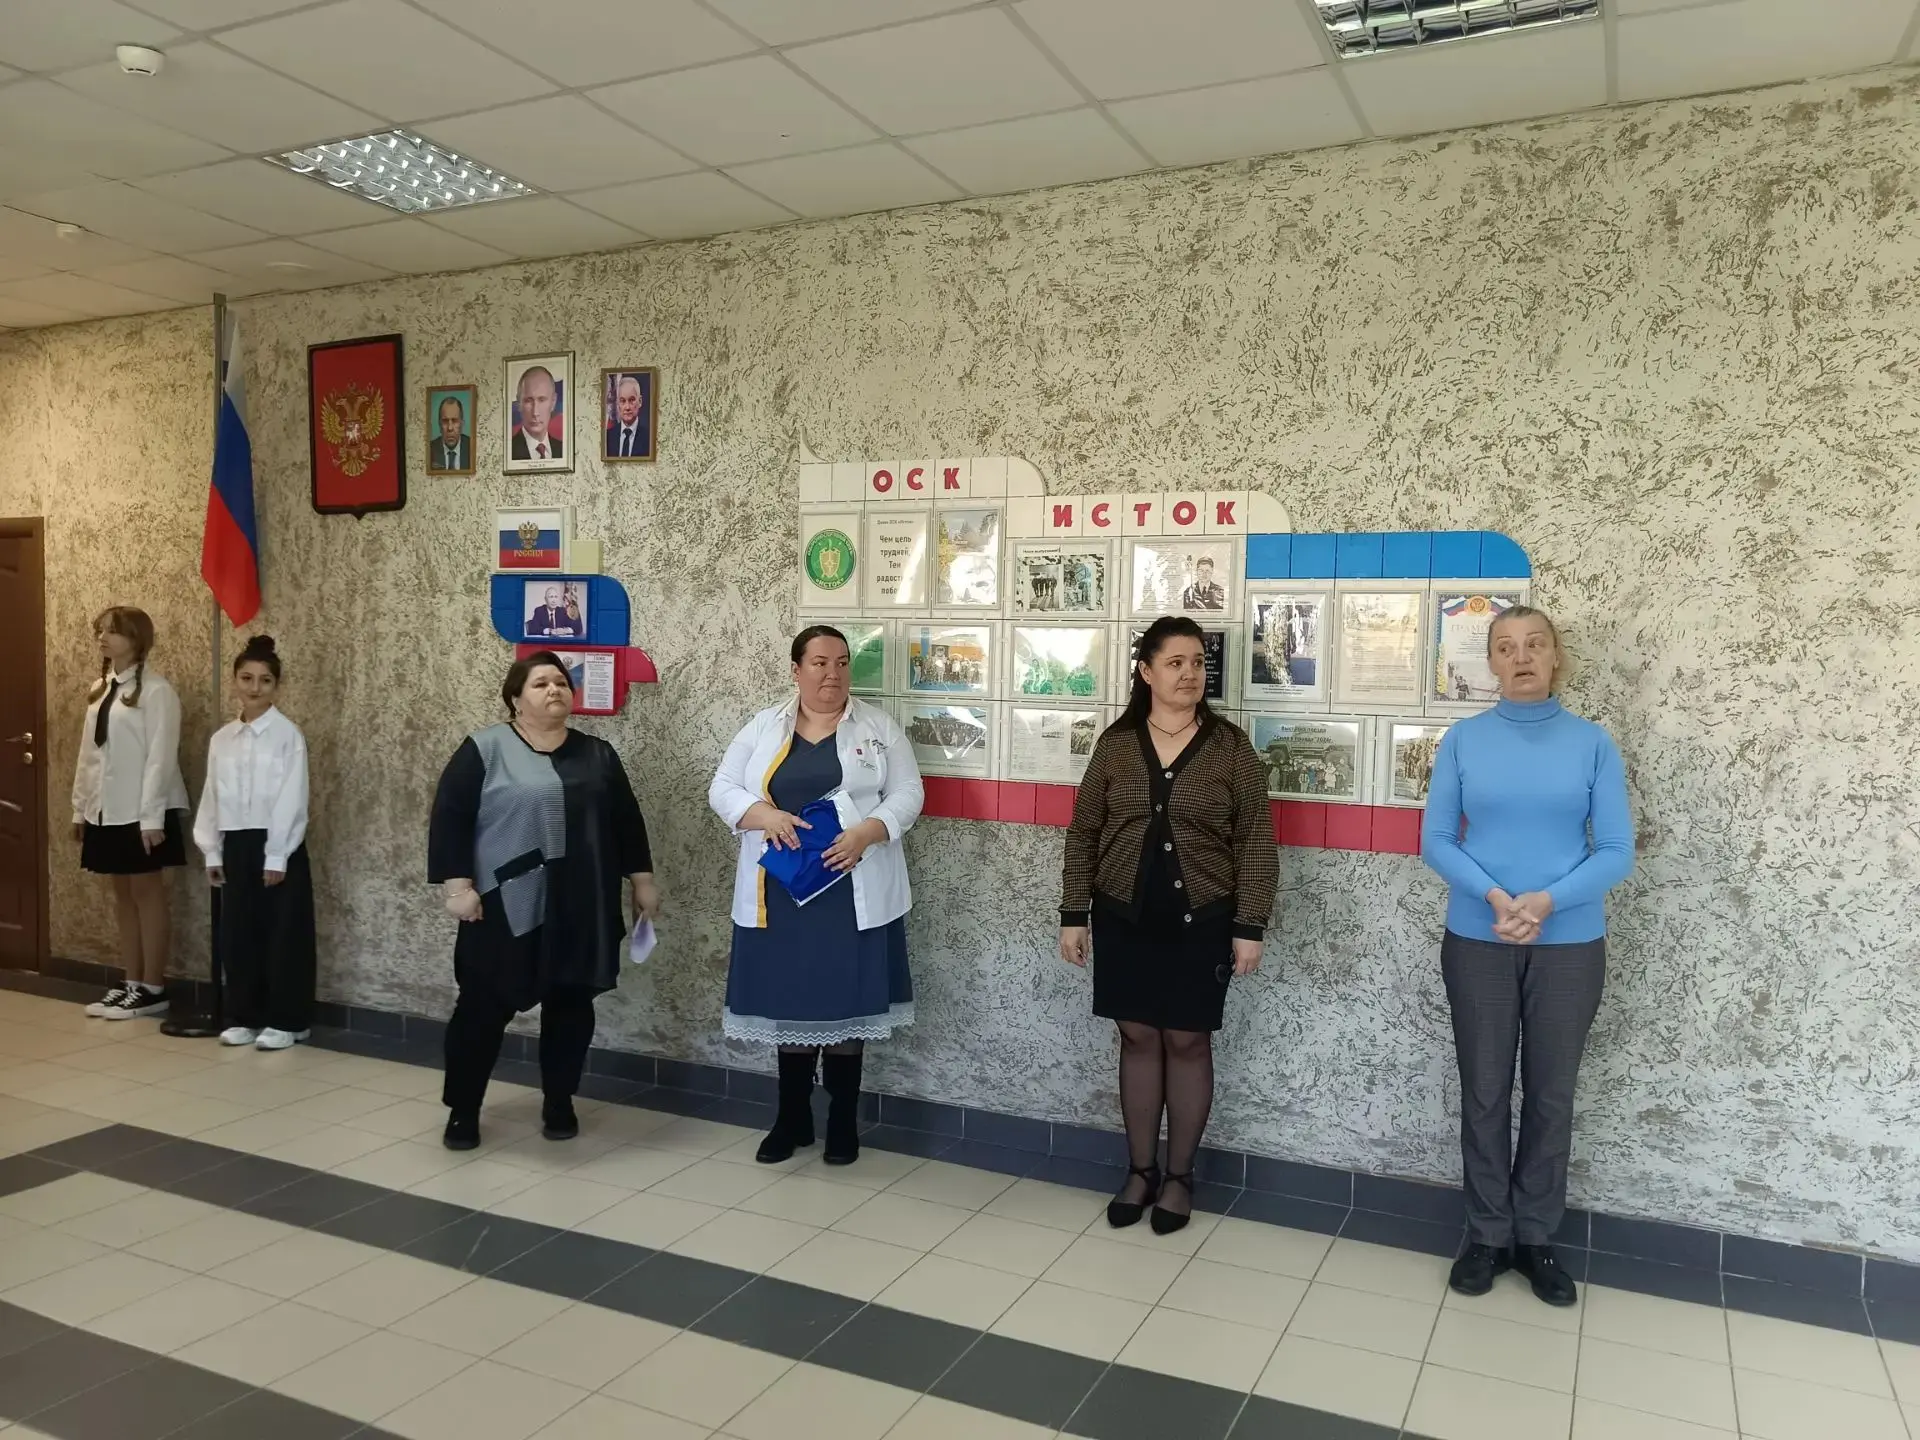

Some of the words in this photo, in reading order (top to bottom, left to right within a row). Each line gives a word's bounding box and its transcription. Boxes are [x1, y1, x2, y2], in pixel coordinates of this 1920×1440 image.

[872, 467, 961, 493] ОСК
[1053, 501, 1236, 527] ИСТОК
[894, 535, 912, 543] цель
